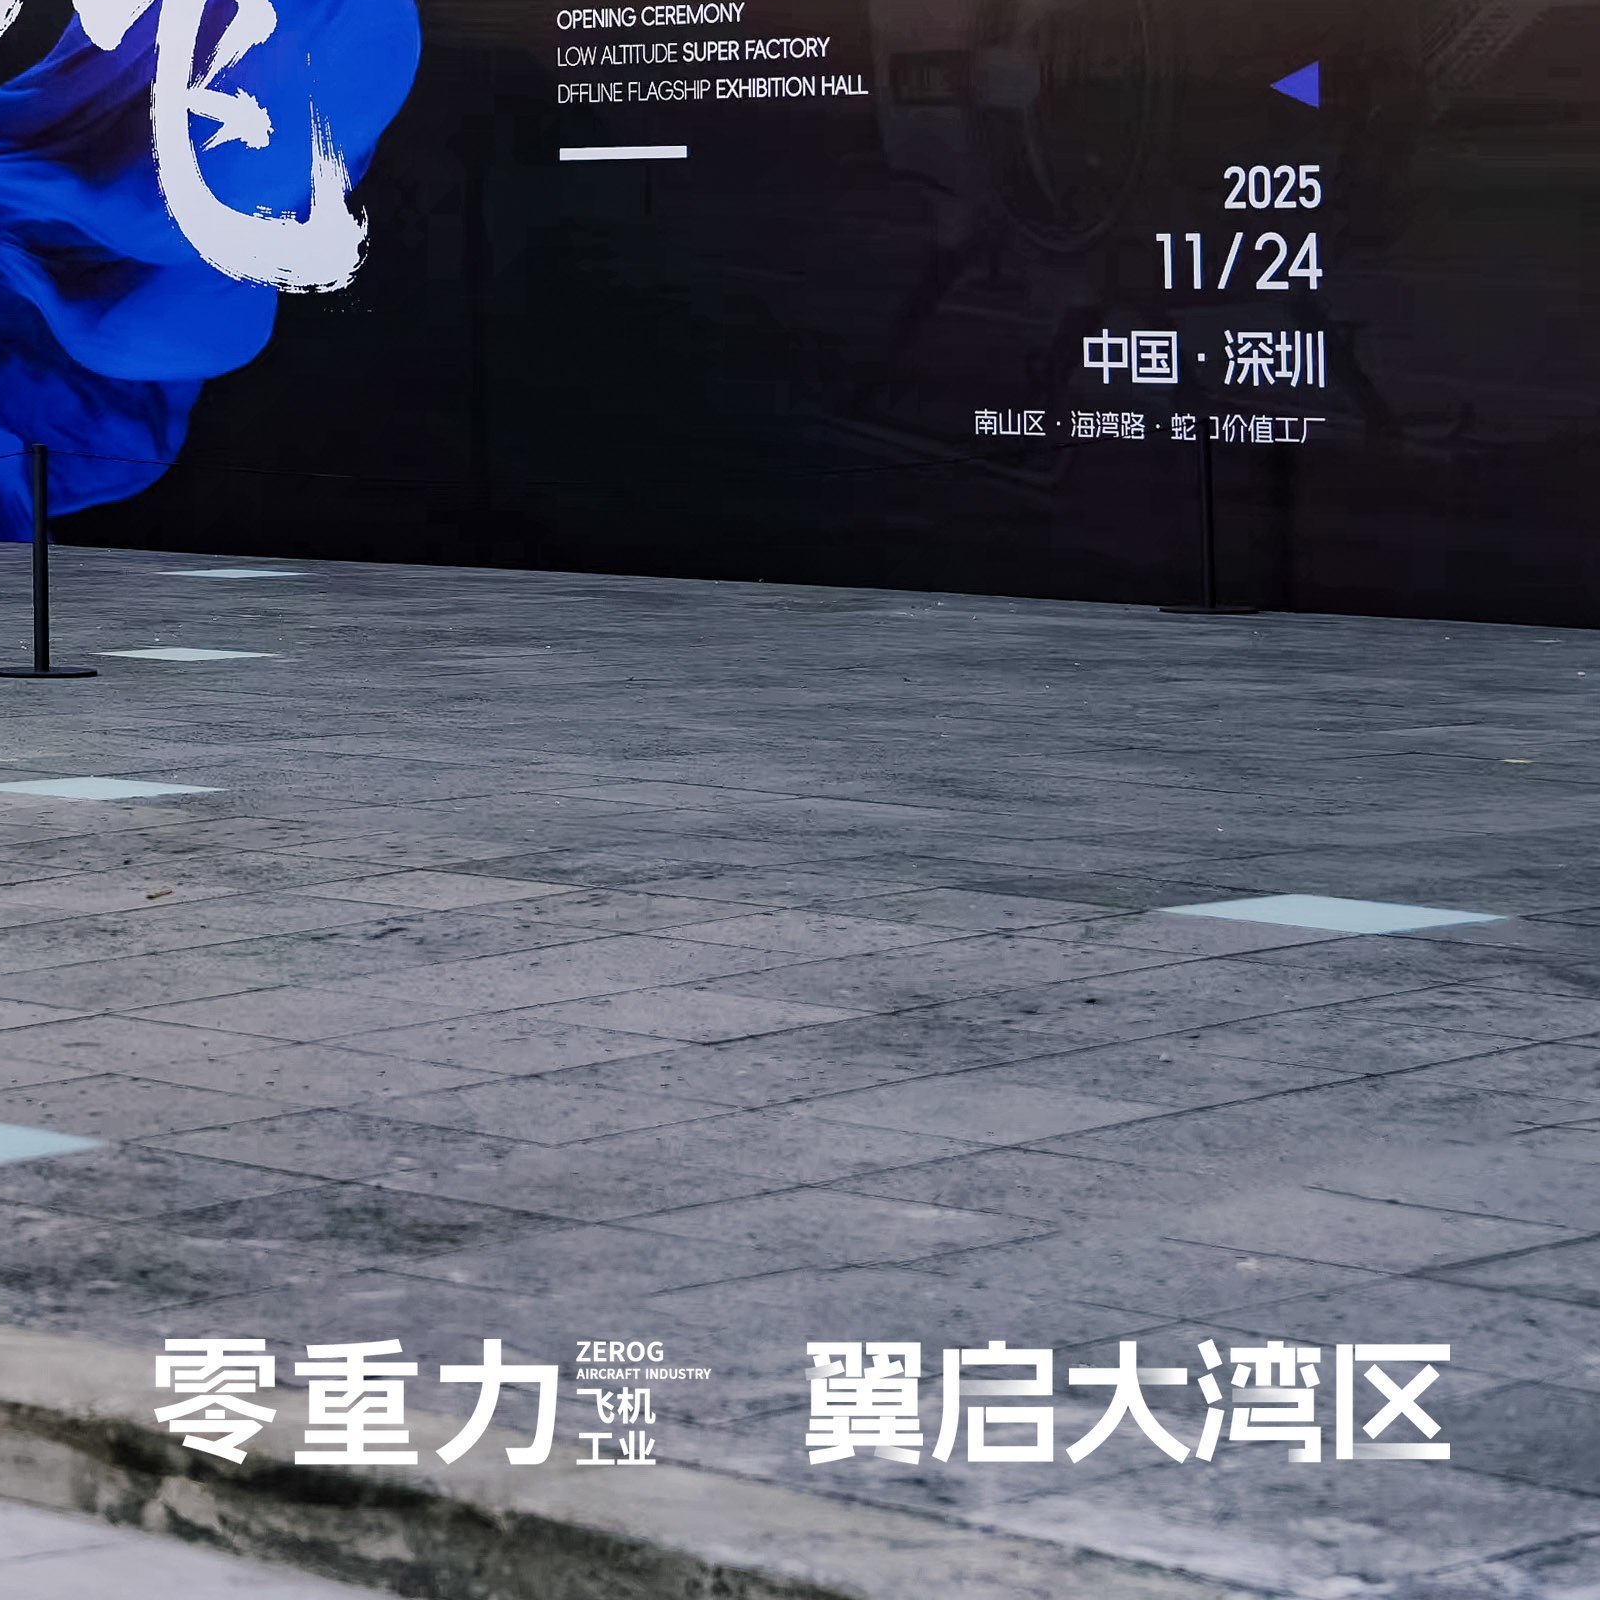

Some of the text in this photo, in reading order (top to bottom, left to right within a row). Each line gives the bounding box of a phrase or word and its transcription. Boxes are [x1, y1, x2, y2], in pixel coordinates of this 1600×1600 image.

[557, 2, 745, 30] OPENING CEREMONY
[557, 37, 831, 67] LOW ALTITUDE SUPER FACTORY
[628, 80, 711, 102] FLAGSHIP
[716, 76, 816, 99] EXHIBITION
[821, 74, 869, 96] HALL
[1223, 164, 1322, 210] 2025
[1156, 232, 1323, 290] 11/24
